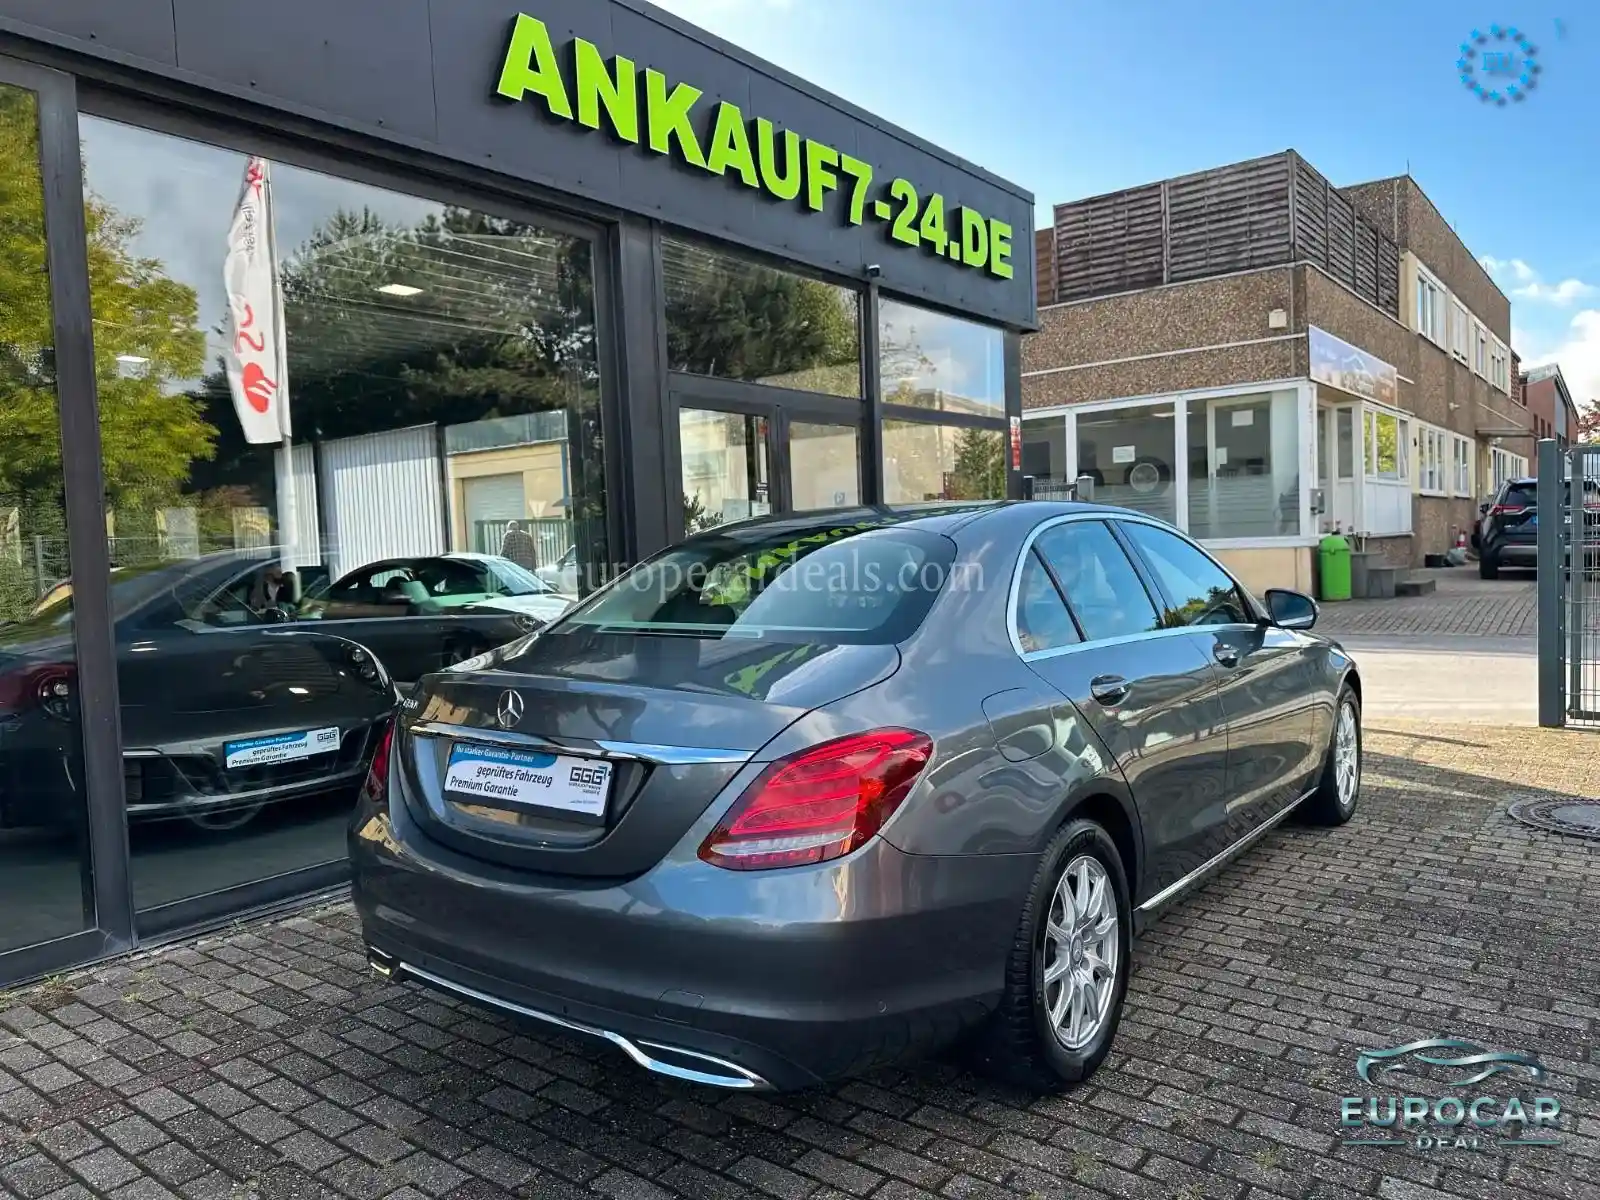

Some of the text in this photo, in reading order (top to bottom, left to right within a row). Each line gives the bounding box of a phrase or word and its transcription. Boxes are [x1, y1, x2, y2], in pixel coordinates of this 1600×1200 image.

[497, 12, 1014, 280] ANKAUF7-24.DE
[450, 776, 519, 797] Premium Garantie
[476, 764, 553, 787] geprüftes Fahrzeug
[570, 766, 604, 785] GGG
